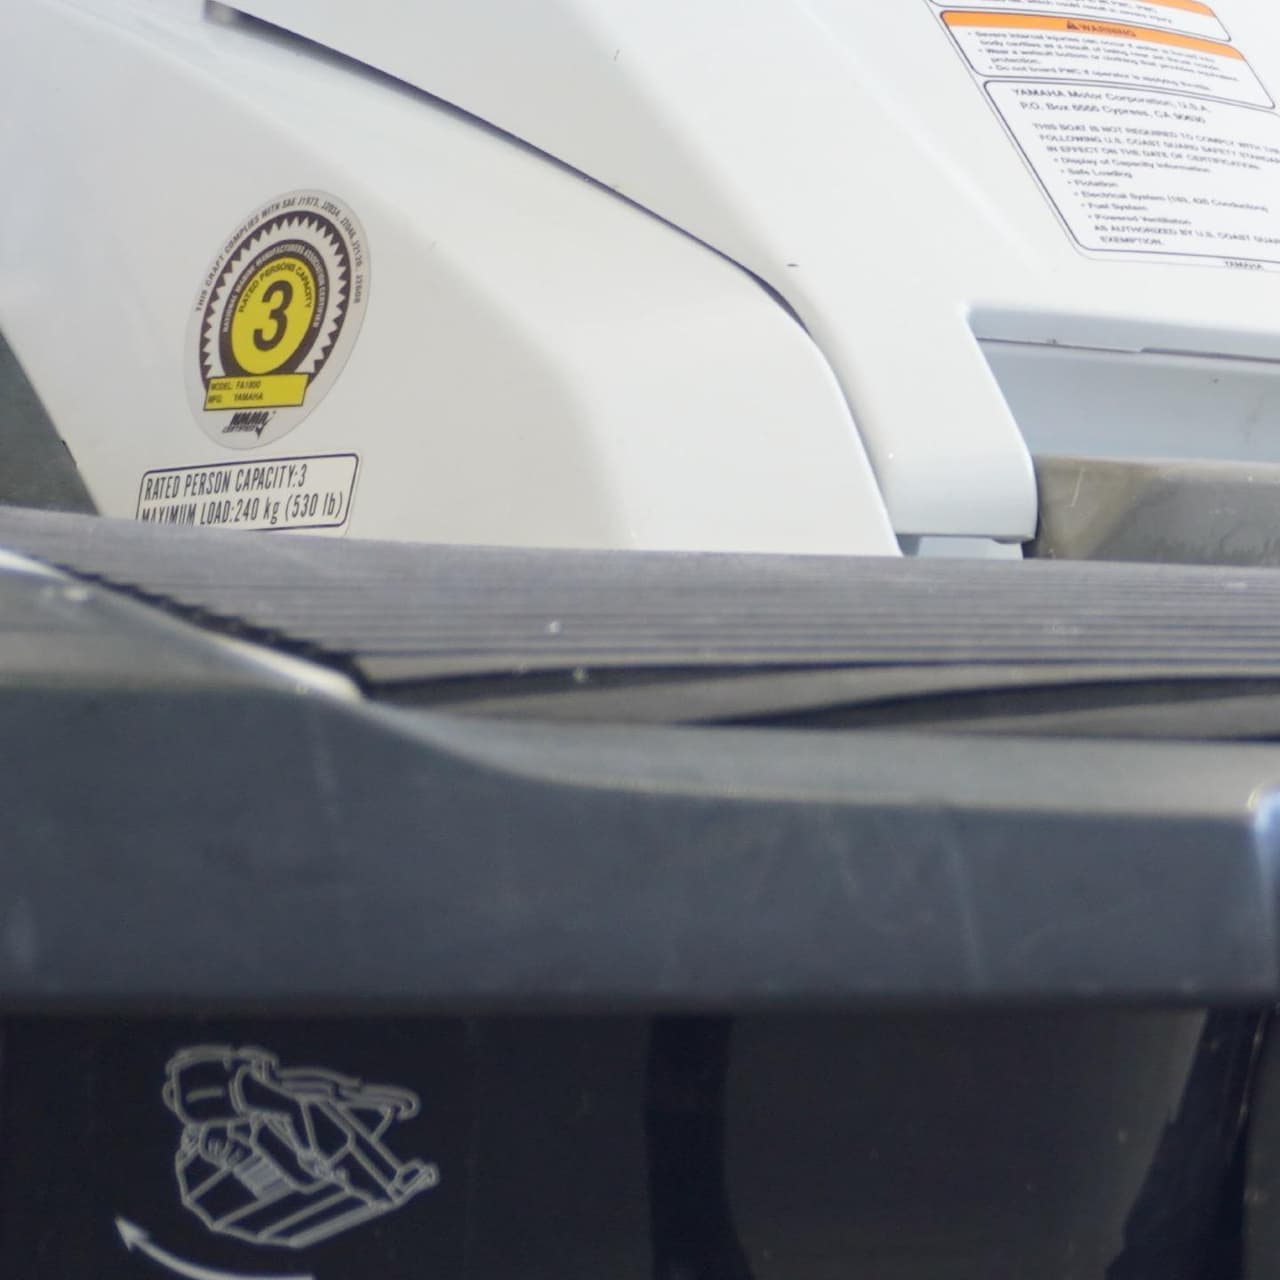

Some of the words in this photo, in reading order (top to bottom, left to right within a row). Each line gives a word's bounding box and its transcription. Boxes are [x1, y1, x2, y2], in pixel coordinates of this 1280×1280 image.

[1012, 88, 1066, 98] YAMAHA
[1067, 90, 1102, 100] Motor
[1020, 101, 1042, 110] P.O.
[1045, 102, 1069, 111] Box
[1040, 134, 1102, 143] FOLLOWING
[206, 256, 225, 287] CRAFT
[224, 214, 261, 254] COMPLIES
[261, 202, 281, 218] WITH
[239, 279, 261, 313] RATED
[296, 266, 312, 308] CAPACITY
[253, 280, 293, 351] 3
[234, 392, 263, 402] YAMAHA
[145, 475, 181, 501] RATED
[183, 470, 233, 497] PERSON
[262, 496, 281, 526] kg
[285, 493, 319, 521] (530
[322, 491, 343, 518] lb)
